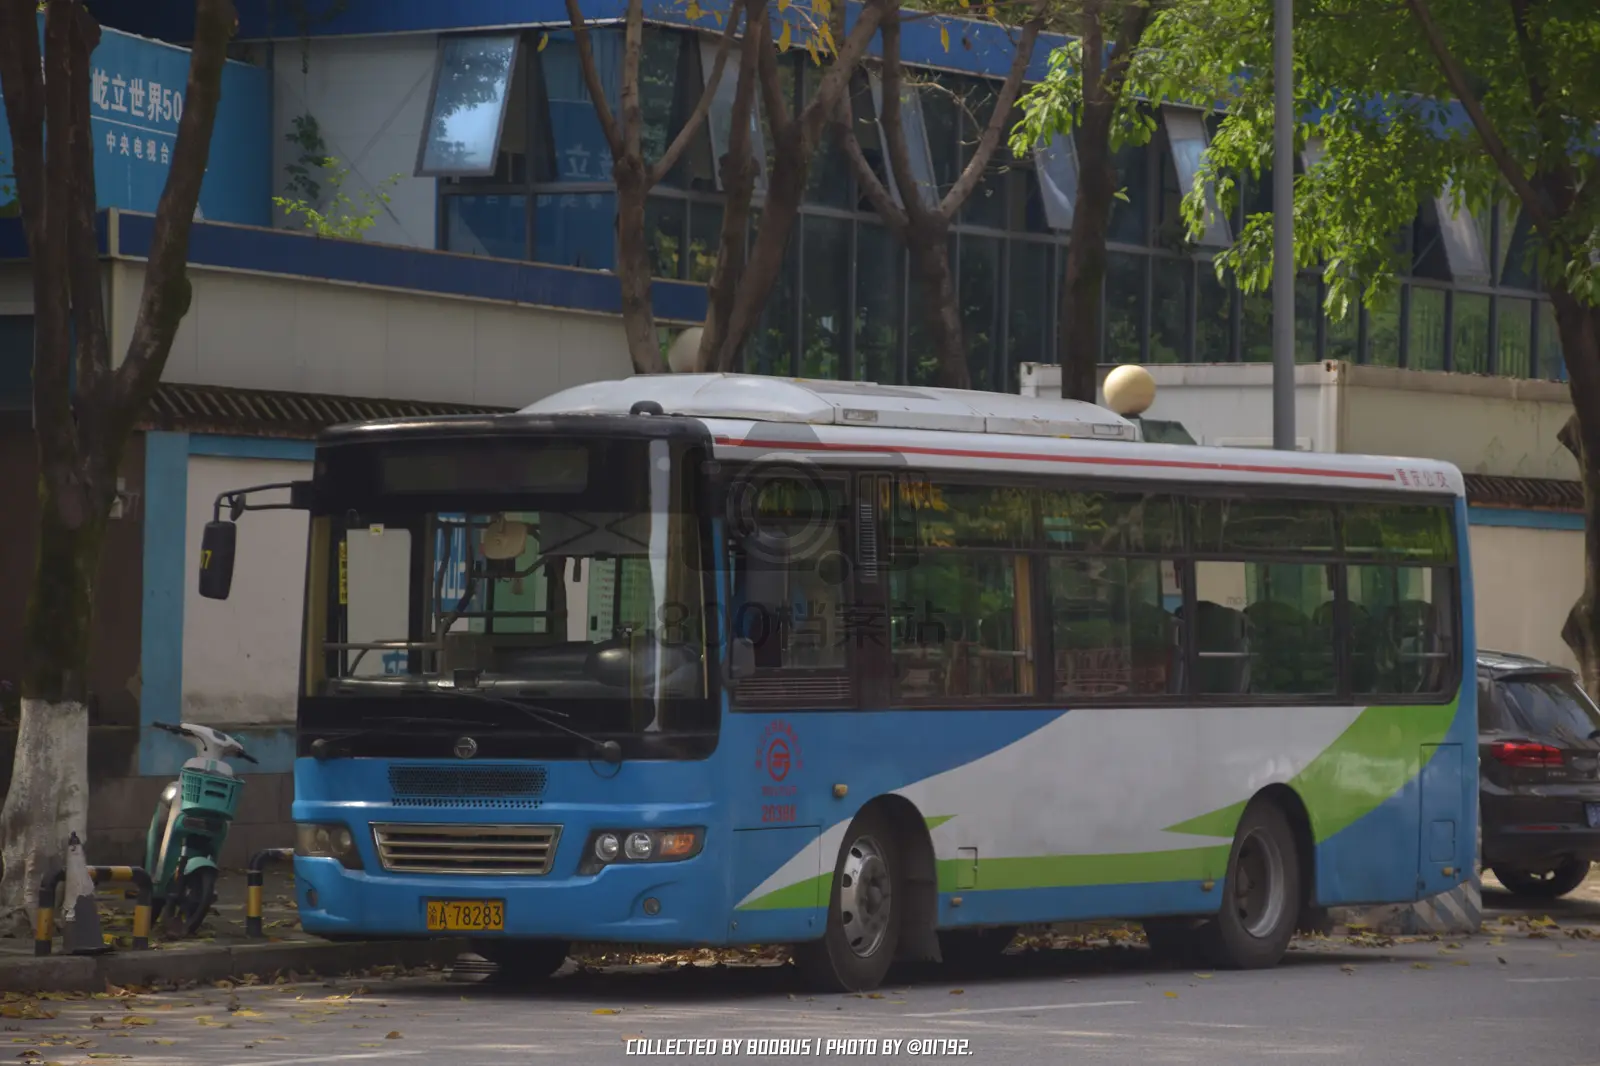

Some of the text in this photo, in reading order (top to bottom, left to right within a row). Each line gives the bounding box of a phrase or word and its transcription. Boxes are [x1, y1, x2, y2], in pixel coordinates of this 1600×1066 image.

[105, 130, 169, 164] 中央电视台
